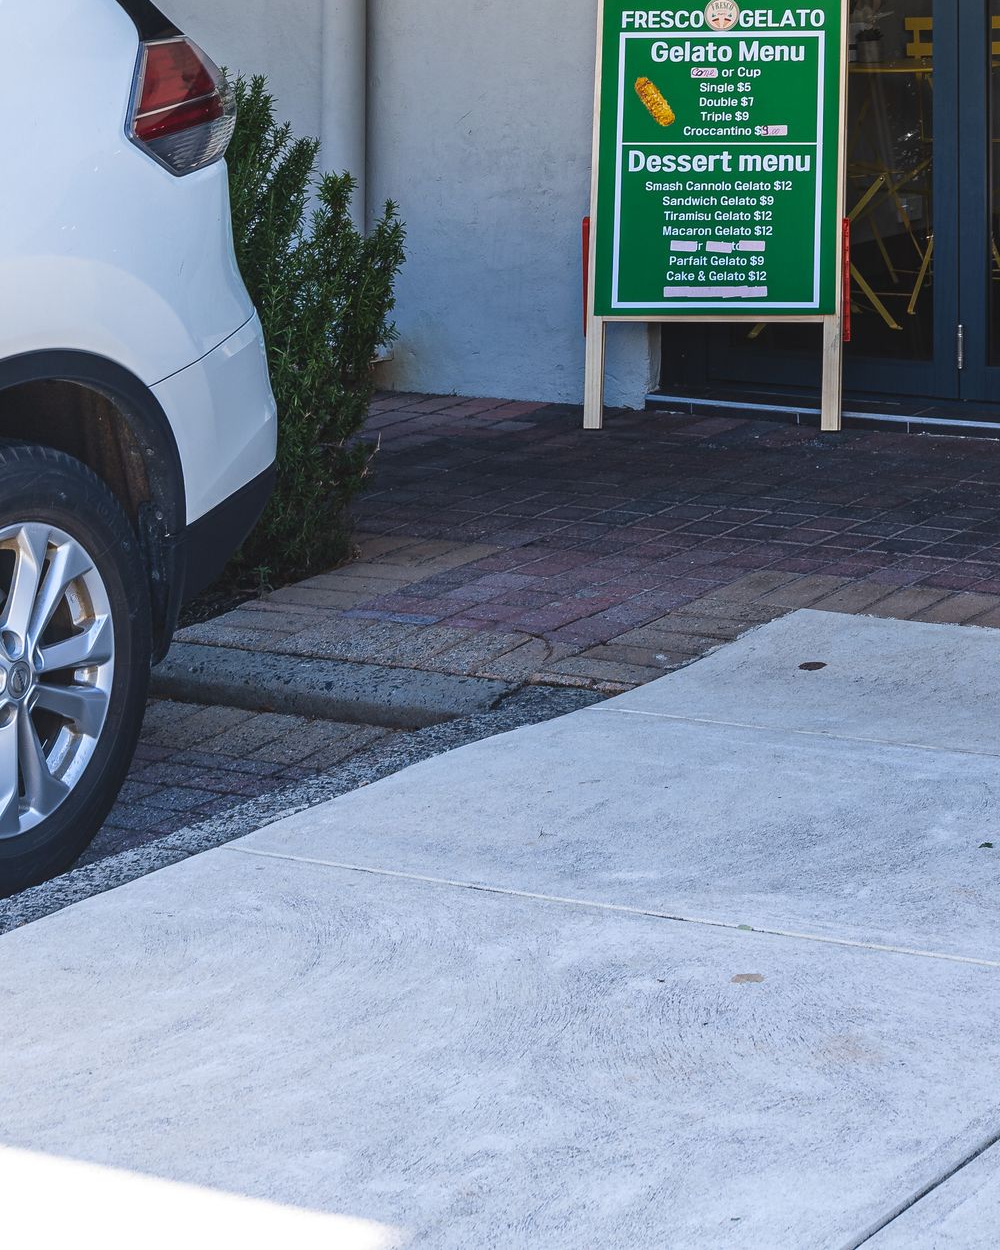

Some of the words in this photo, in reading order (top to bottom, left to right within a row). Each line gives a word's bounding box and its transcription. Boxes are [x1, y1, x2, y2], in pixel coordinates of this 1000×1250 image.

[621, 10, 704, 29] FRESCO
[739, 9, 825, 28] GELATO
[651, 41, 732, 62] Gelato
[738, 41, 805, 62] Menu
[722, 69, 734, 77] or
[738, 67, 761, 78] Cup
[700, 83, 734, 93] Single
[737, 82, 751, 92] $5
[700, 97, 738, 106] Double
[741, 97, 753, 106] $7
[701, 112, 732, 122] Triple
[735, 111, 749, 121] $9
[684, 126, 751, 135] Croccantino
[629, 150, 732, 172] Dessert
[739, 155, 810, 171] menu
[646, 182, 682, 190] Smash
[686, 181, 731, 190] Cannolo
[735, 181, 771, 190] Gelato
[774, 181, 792, 190] $12
[663, 196, 717, 205] Sandwich
[721, 196, 756, 205] Gelato
[760, 195, 774, 205] $9
[664, 211, 711, 220] Tiramisu
[715, 211, 750, 220] Gelato
[754, 211, 772, 221] $12
[663, 226, 711, 235] Macaron
[715, 226, 751, 235] Gelato
[755, 226, 772, 236] $12
[670, 256, 707, 265] Parfait
[711, 256, 747, 265] Gelato
[750, 256, 764, 266] $9
[667, 271, 694, 280] Cake
[698, 271, 705, 281] &
[709, 271, 745, 280] Gelato
[749, 271, 766, 281] $12
